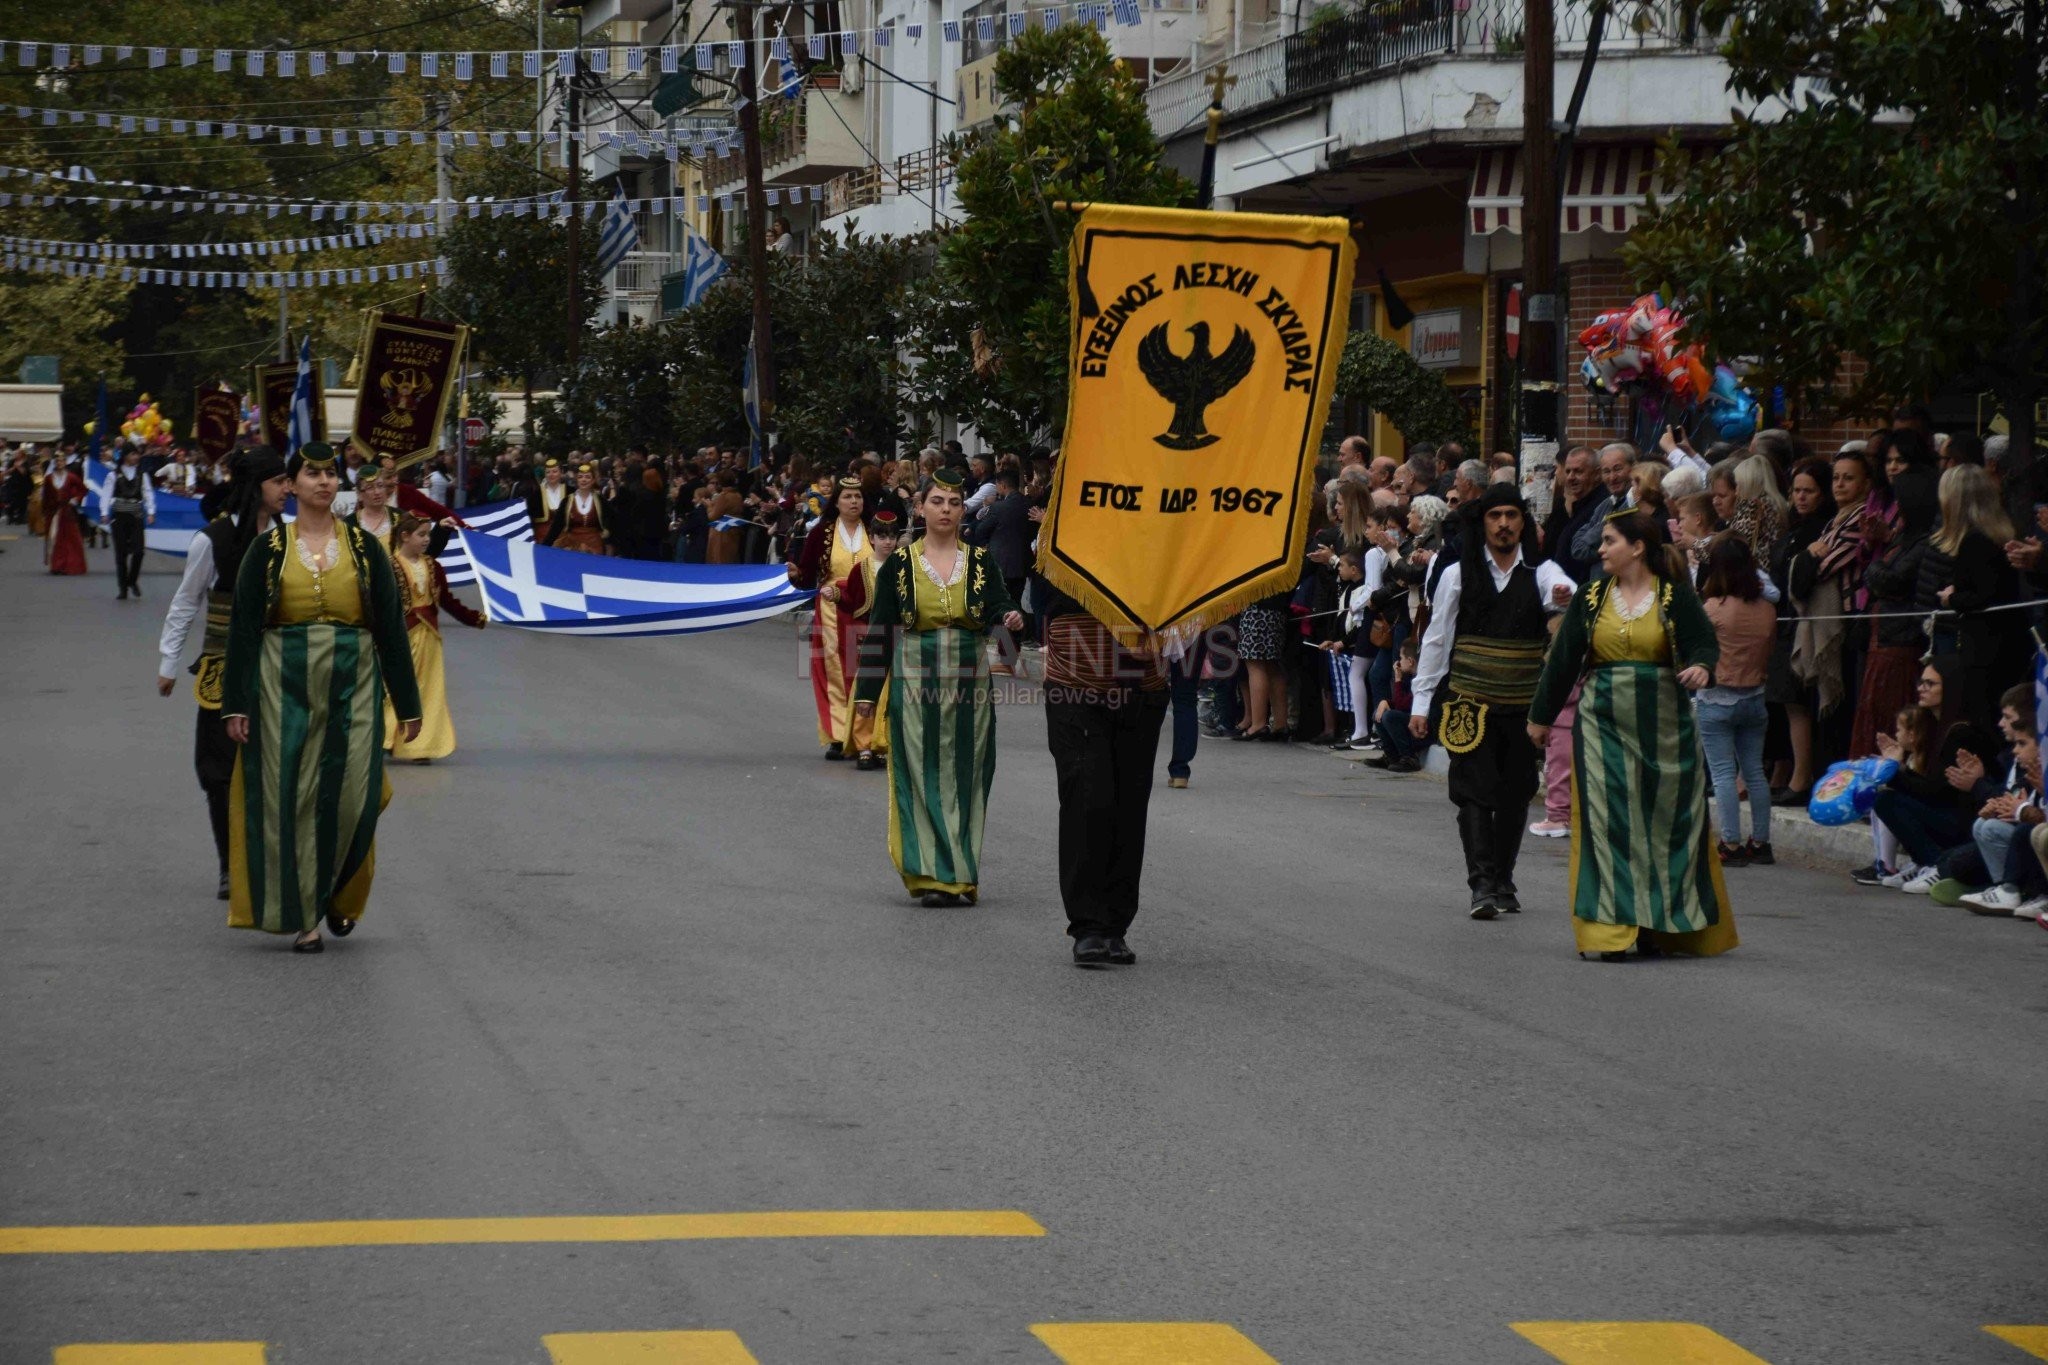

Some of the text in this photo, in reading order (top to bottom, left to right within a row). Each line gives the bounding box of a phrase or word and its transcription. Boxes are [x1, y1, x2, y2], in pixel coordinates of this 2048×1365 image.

[1080, 262, 1313, 394] ΕΥΞΕΙΝΟΣ ΛΕΣΧΗ ΣΚΥΔΡΑΣ
[1080, 481, 1283, 517] ΕΤΟΣ ΙΔΡ. 1967
